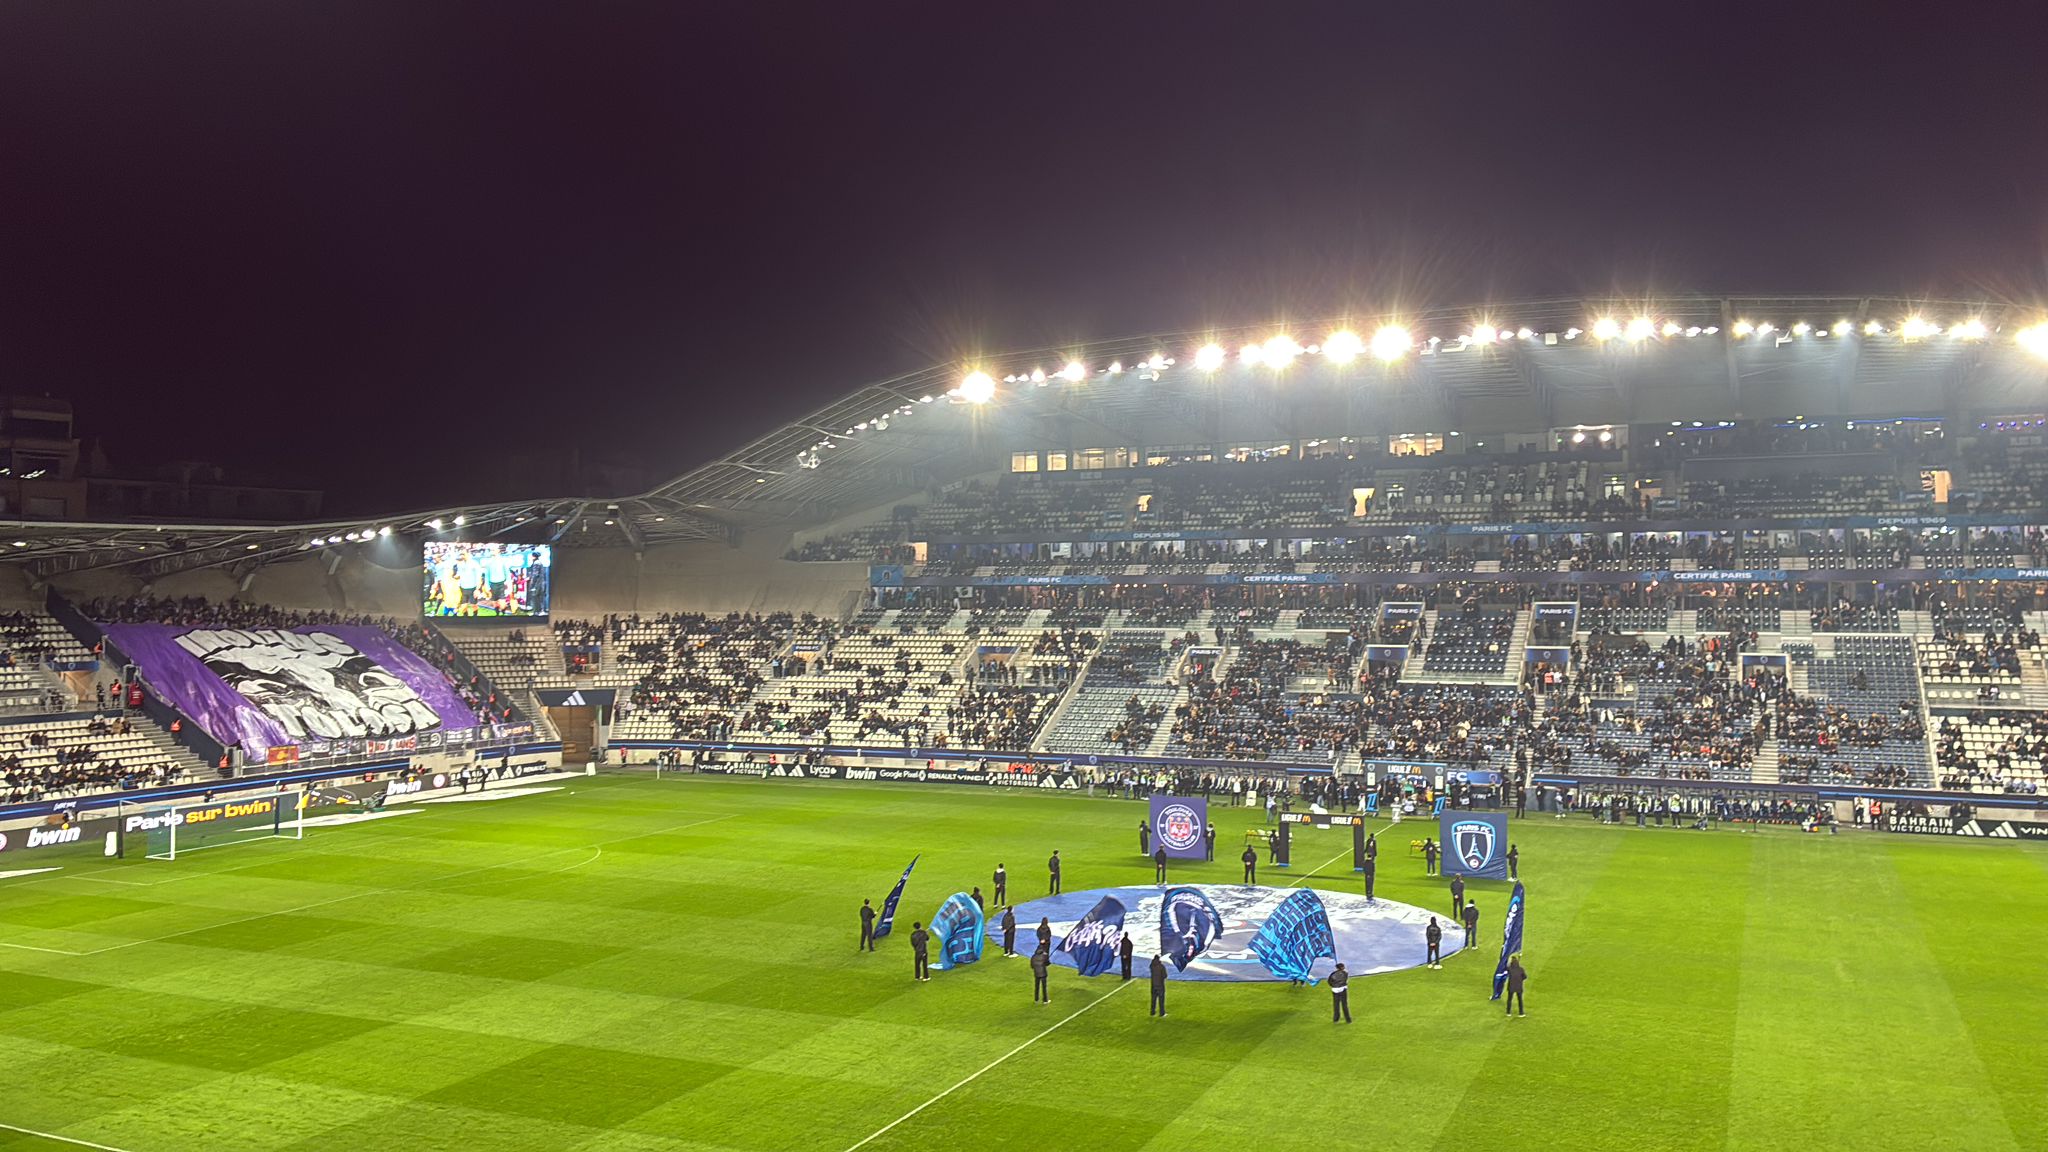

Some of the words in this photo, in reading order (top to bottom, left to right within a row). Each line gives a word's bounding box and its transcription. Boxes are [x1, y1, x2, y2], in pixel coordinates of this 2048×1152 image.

[1673, 571, 1720, 580] CERTIFIÉ
[845, 767, 877, 780] bwin
[880, 769, 902, 779] Google
[903, 770, 919, 778] Pixel
[997, 773, 1038, 781] BAHRAIN
[1447, 771, 1468, 782] FC
[386, 776, 422, 796] bwin
[186, 807, 222, 823] sur
[224, 799, 271, 818] bwin
[1889, 816, 1953, 827] BAHRAIN
[1456, 824, 1480, 832] PARIS
[1890, 825, 1953, 834] VICTORIOUS
[2020, 827, 2048, 836] VIN
[26, 823, 81, 848] bwin
